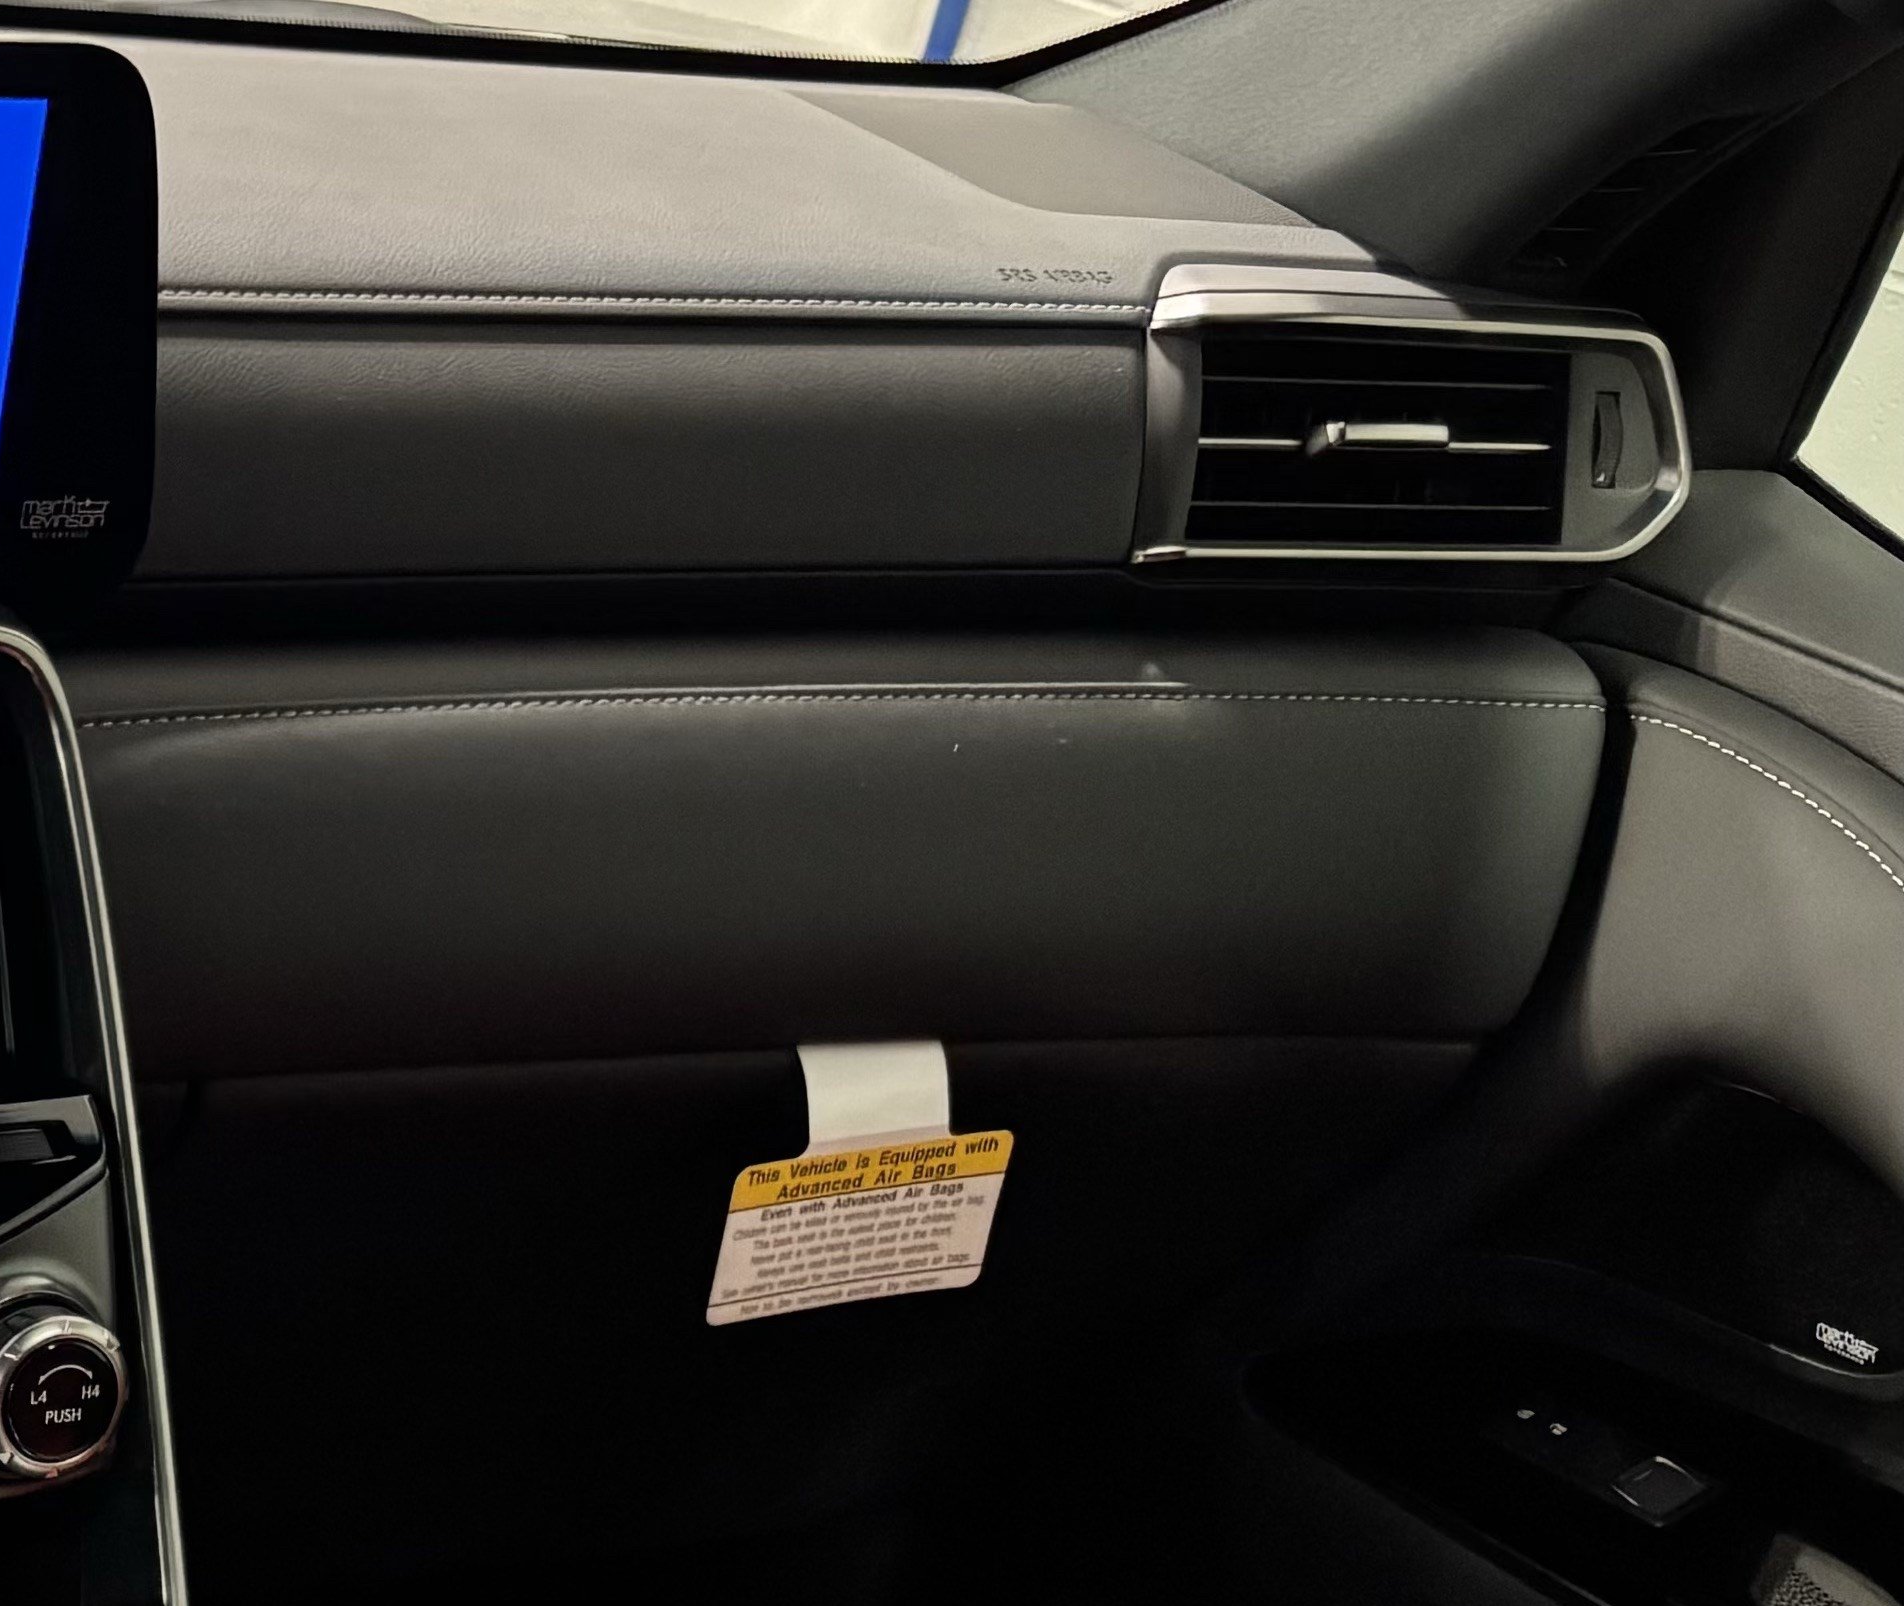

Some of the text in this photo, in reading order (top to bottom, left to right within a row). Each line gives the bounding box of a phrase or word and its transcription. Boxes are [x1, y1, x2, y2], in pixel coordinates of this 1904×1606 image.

[749, 1169, 780, 1186] This
[792, 1160, 847, 1179] Vehicle
[879, 1143, 956, 1166] Equipped
[965, 1138, 998, 1155] with
[777, 1162, 956, 1200] Advanced Air Bags
[832, 1189, 897, 1209] Advanced
[930, 1183, 963, 1196] Bags
[30, 1390, 47, 1407] L4
[81, 1384, 101, 1400] H4
[45, 1408, 81, 1425] PUSH
